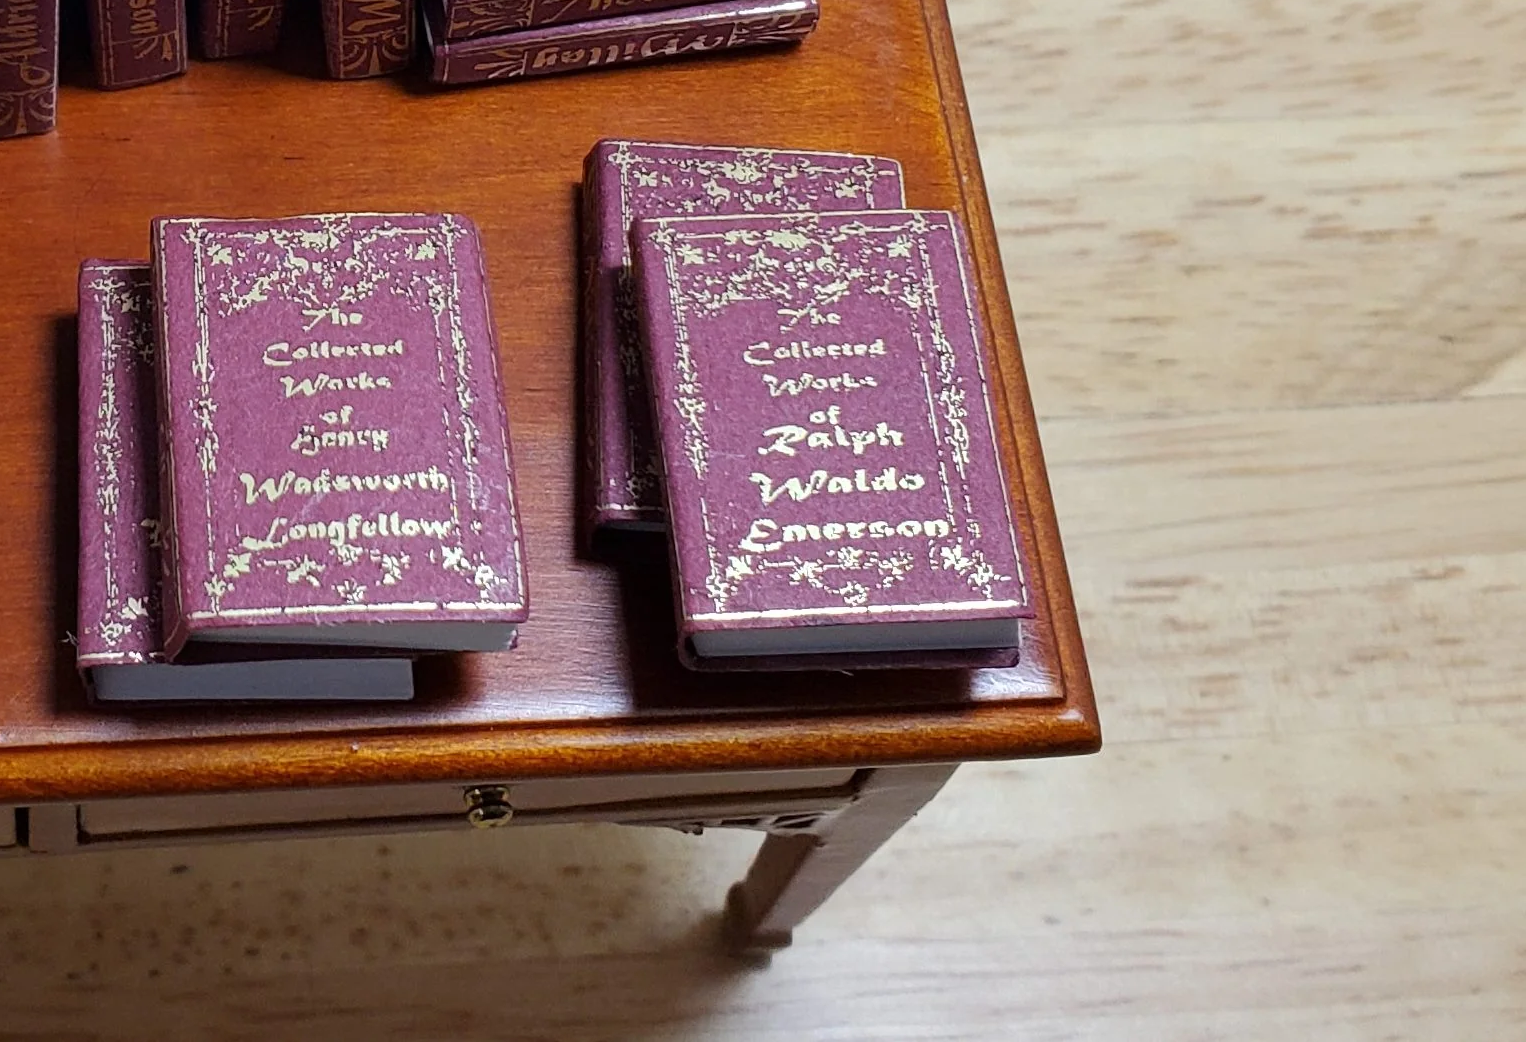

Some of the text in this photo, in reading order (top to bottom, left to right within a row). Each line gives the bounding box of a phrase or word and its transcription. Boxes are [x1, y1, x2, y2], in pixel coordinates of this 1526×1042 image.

[302, 307, 363, 332] The
[778, 305, 841, 333] The
[262, 339, 403, 366] Collected
[743, 338, 887, 366] Collected
[280, 372, 392, 398] Works
[762, 372, 877, 397] Works
[319, 405, 354, 424] of
[809, 405, 841, 424] of
[291, 424, 389, 456] Henry
[758, 422, 903, 456] Ralph
[240, 465, 449, 504] Wadsworth
[749, 467, 925, 506] Waldo
[239, 511, 453, 551] Longfellow
[739, 518, 949, 552] Emerson
